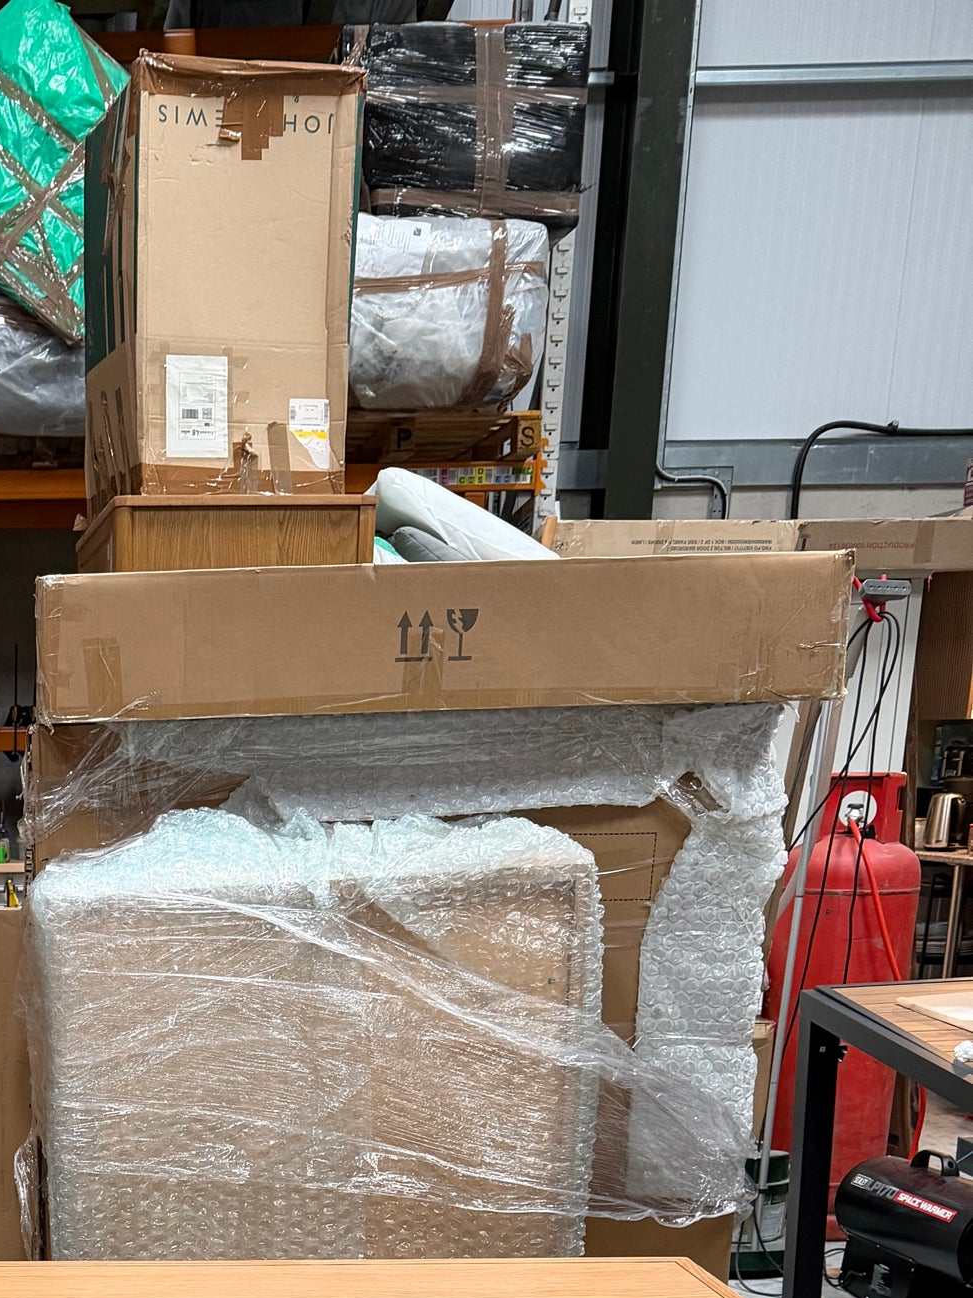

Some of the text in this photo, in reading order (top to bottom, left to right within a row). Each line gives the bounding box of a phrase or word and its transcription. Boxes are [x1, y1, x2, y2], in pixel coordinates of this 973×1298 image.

[158, 104, 334, 135] JOH EWIS
[396, 427, 413, 449] P
[520, 426, 535, 447] S
[866, 542, 915, 550] PRODUCTION
[896, 1192, 923, 1208] SPACE
[919, 1199, 955, 1220] WARMER
